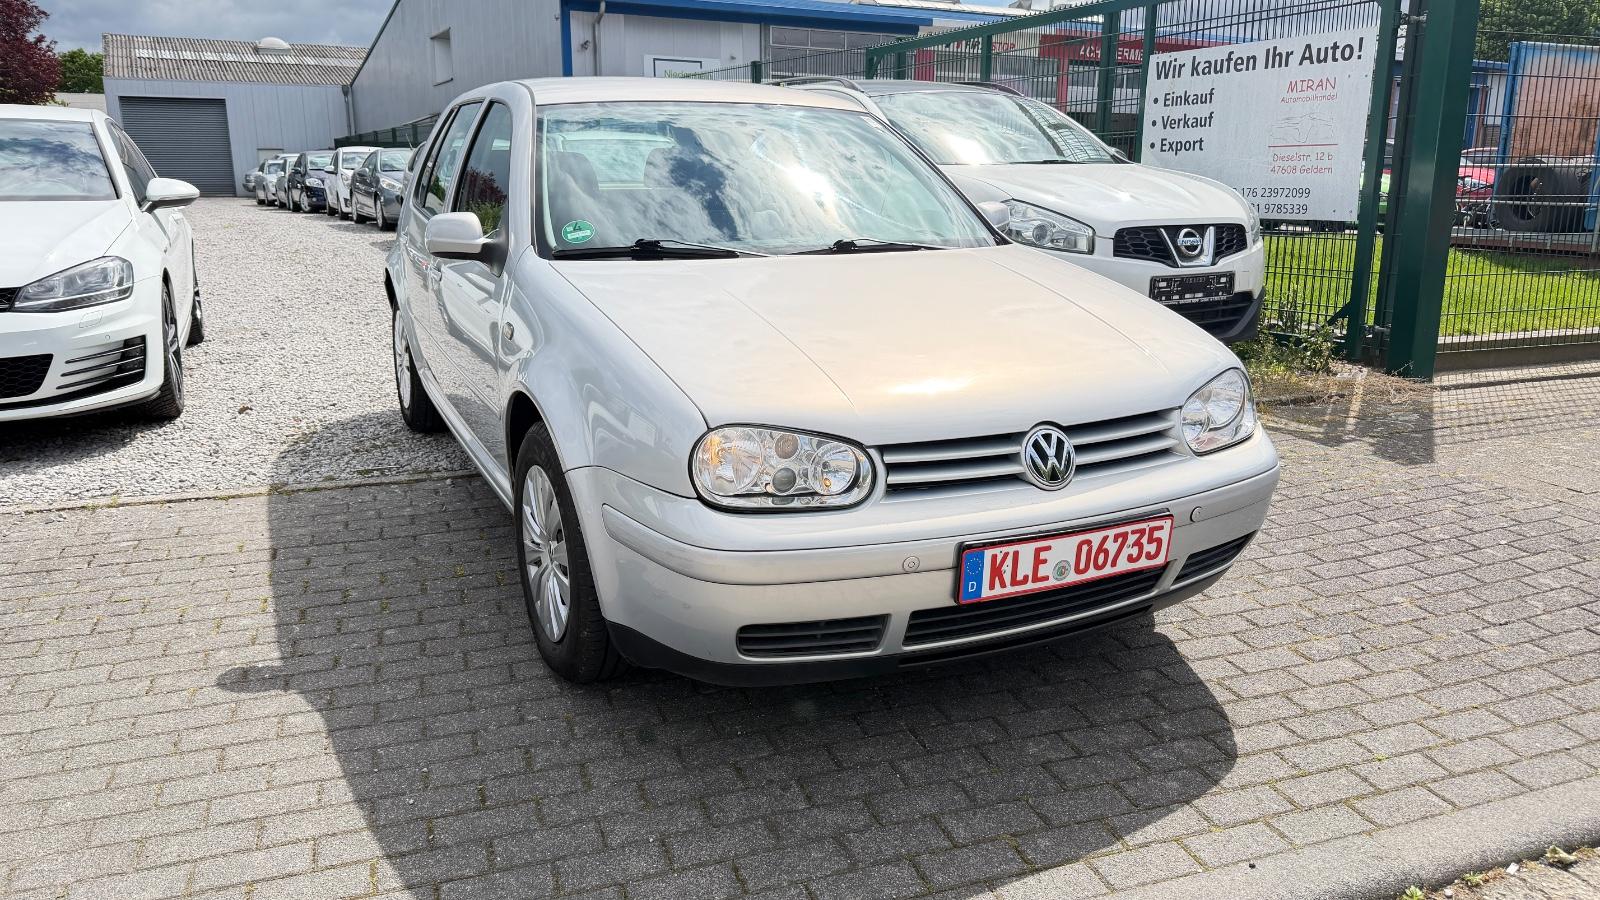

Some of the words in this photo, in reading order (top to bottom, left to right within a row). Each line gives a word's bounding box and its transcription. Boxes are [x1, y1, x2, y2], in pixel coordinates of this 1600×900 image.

[1155, 57, 1186, 80] Wir
[1190, 51, 1257, 77] kaufen
[1264, 45, 1294, 70] Ihr
[1299, 36, 1364, 66] Auto!
[1286, 76, 1337, 94] MIRAN
[1163, 87, 1215, 107] Einkauf
[1280, 92, 1338, 104] Automobilhandel
[1161, 111, 1215, 130] Verkauf
[1159, 137, 1204, 156] Export
[1272, 152, 1312, 162] Dieselstr.
[1315, 151, 1325, 161] 12
[1327, 152, 1333, 161] b
[1270, 165, 1297, 175] 47608
[1299, 164, 1333, 175] Geldern
[1260, 187, 1311, 199] 23972099
[1264, 203, 1308, 215] 9785339
[988, 545, 1052, 591] KLE
[1074, 524, 1165, 575] 06735
[968, 580, 977, 593] D
